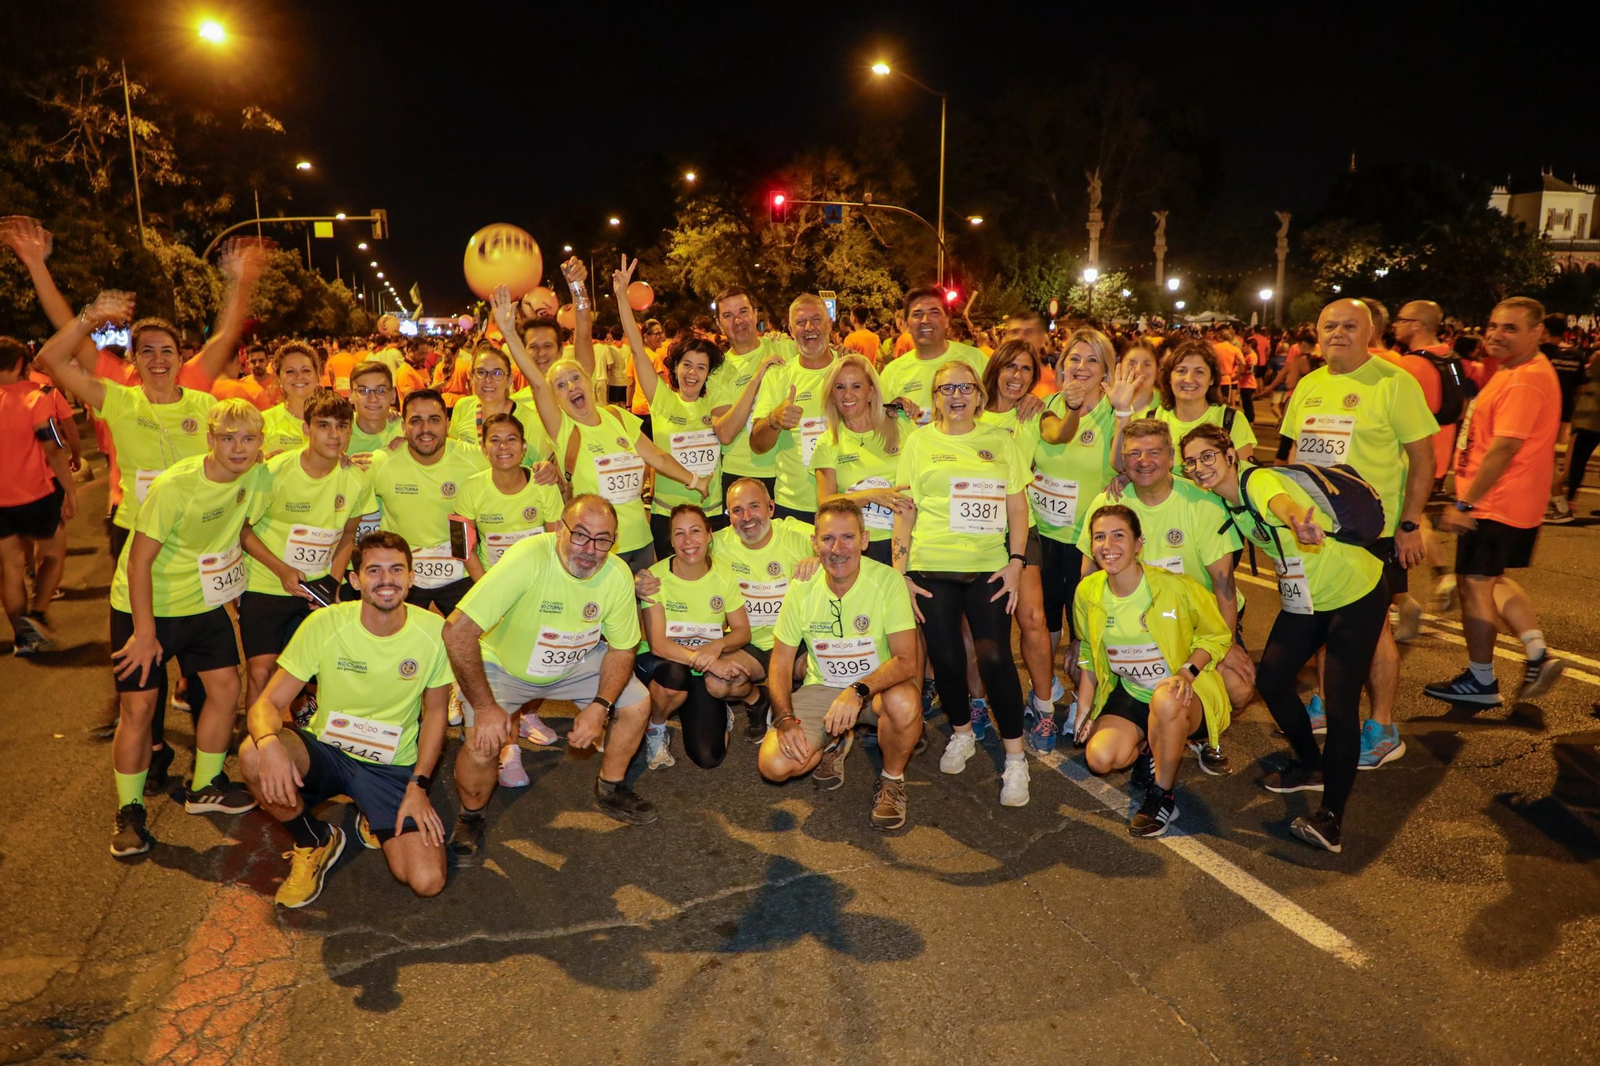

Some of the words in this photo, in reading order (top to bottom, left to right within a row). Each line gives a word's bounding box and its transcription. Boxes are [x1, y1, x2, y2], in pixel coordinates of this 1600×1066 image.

[1299, 438, 1346, 455] 22353
[679, 449, 715, 465] 3378
[607, 473, 640, 491] 3373
[960, 502, 998, 519] 3381
[1033, 492, 1068, 515] 3412
[212, 562, 245, 591] 3420
[413, 562, 454, 577] 3389
[745, 600, 782, 614] 3402
[541, 648, 588, 664] 3390
[826, 659, 870, 675] 3395
